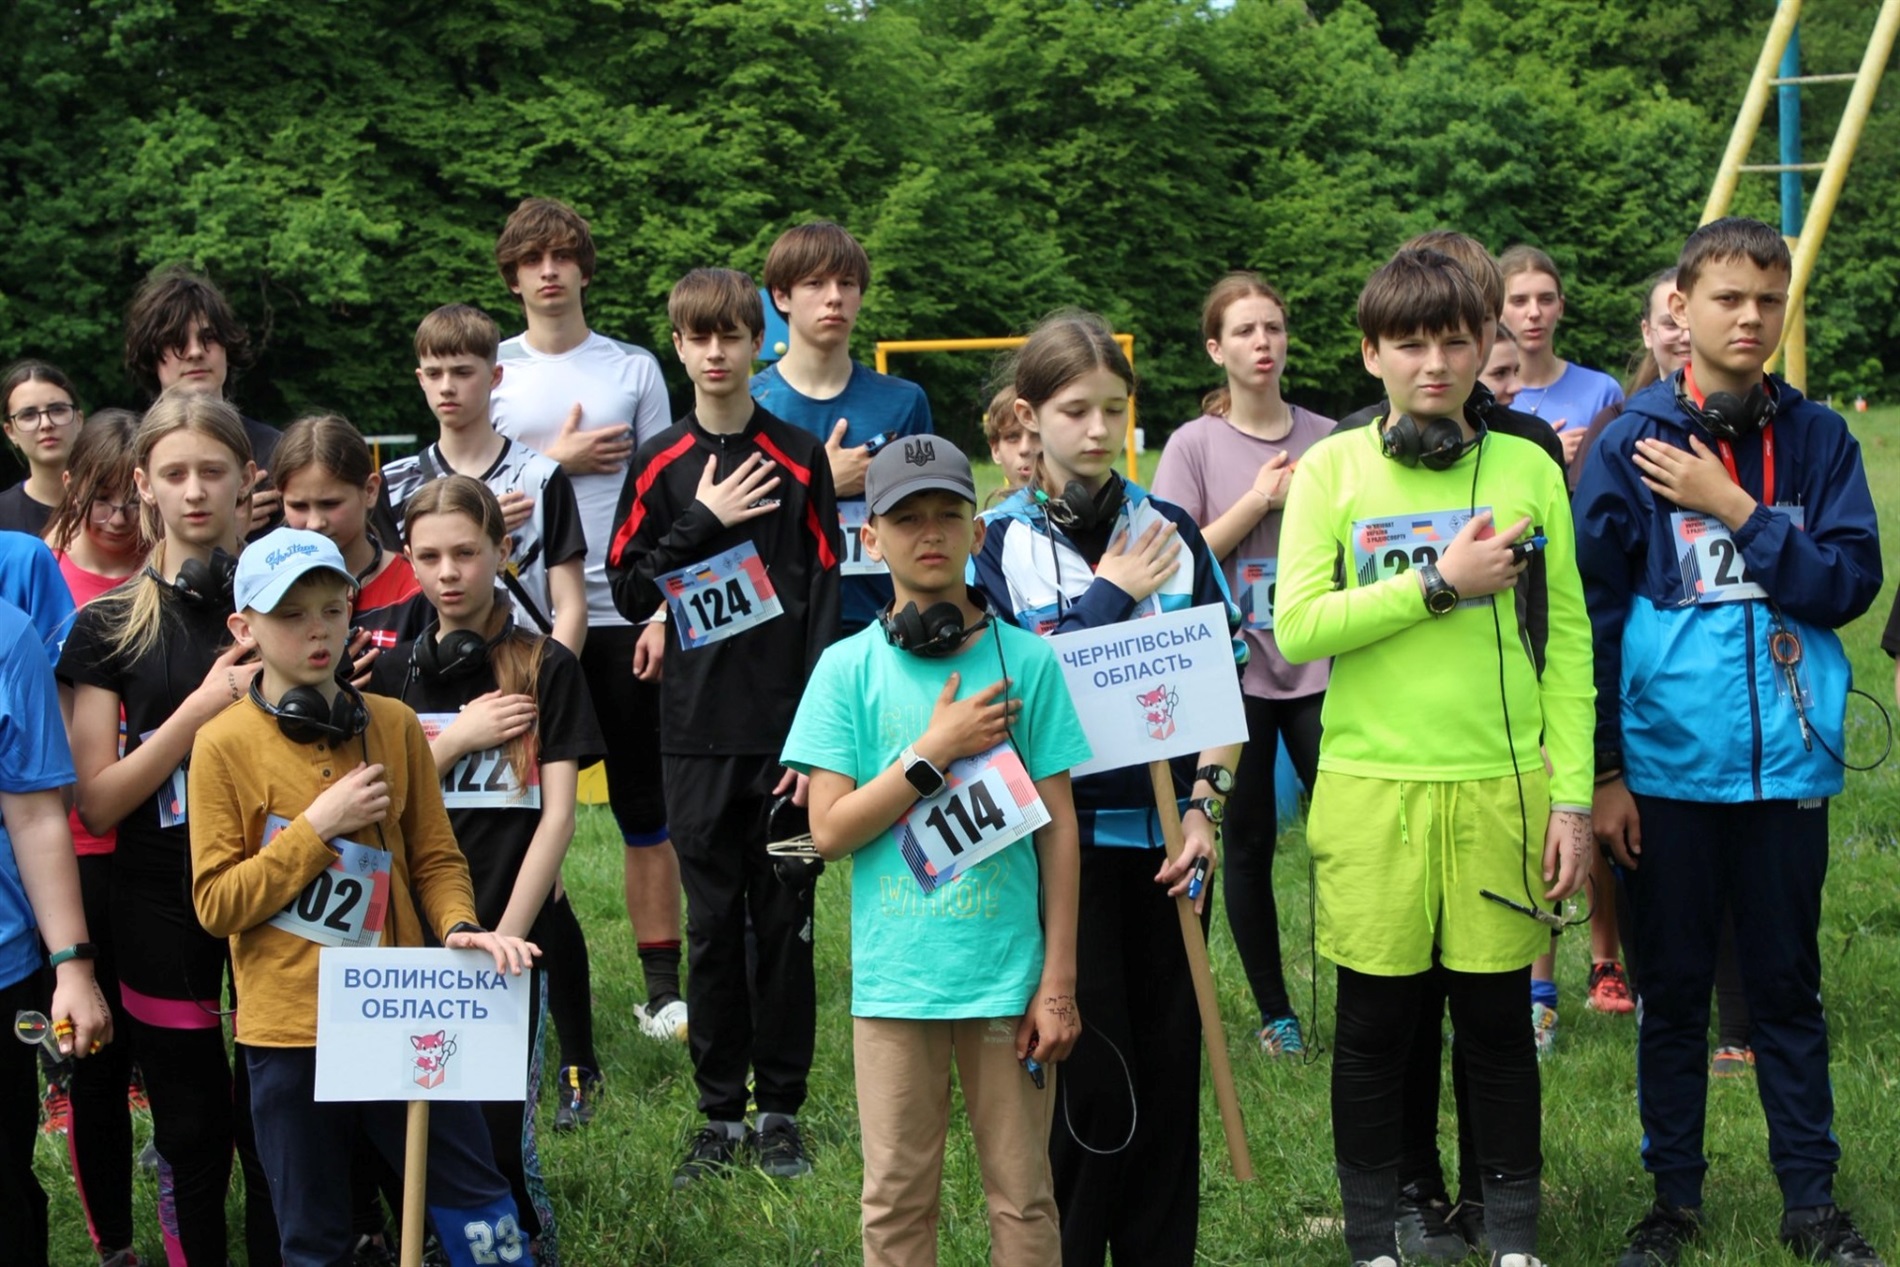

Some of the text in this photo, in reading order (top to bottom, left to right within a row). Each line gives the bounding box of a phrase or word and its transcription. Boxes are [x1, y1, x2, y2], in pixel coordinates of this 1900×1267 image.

[689, 578, 752, 631] 124
[1063, 623, 1212, 668] ЧЕРНІГІВСЬКА
[1093, 653, 1193, 688] ОБЛАСТЬ
[925, 779, 1007, 856] 114
[282, 869, 362, 932] 02
[344, 968, 508, 990] ВОЛИНСЬКА
[361, 998, 488, 1019] ОБЛАСТЬ
[464, 1213, 523, 1264] 23
